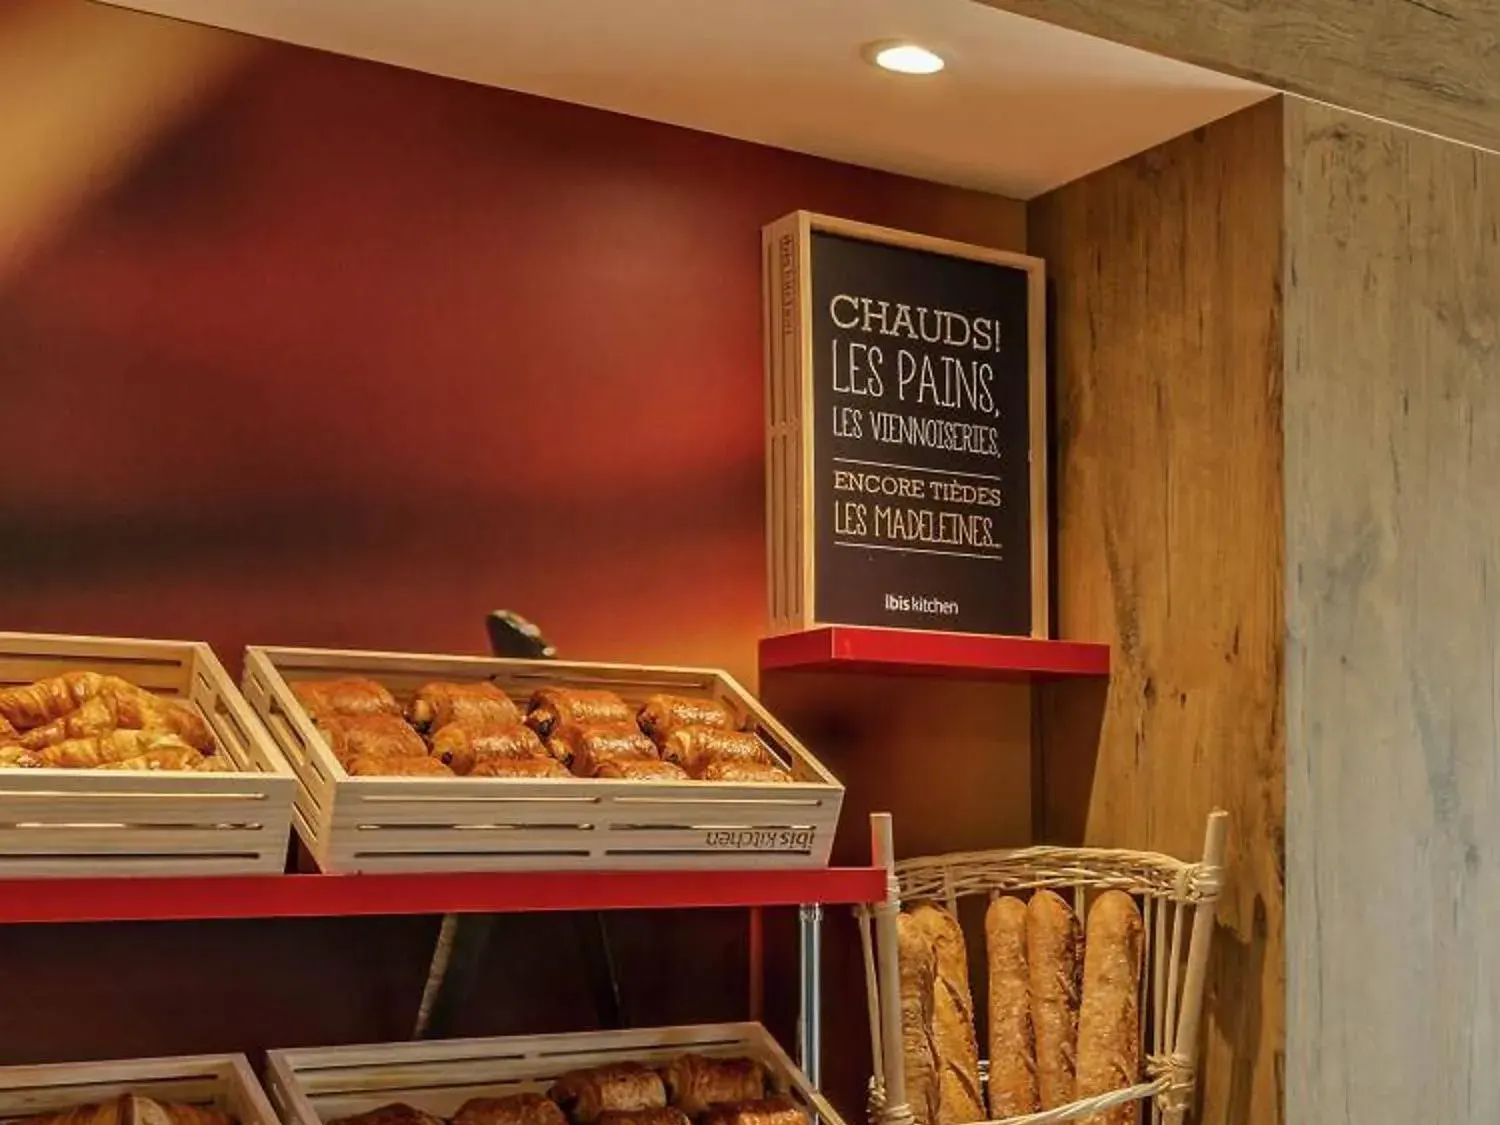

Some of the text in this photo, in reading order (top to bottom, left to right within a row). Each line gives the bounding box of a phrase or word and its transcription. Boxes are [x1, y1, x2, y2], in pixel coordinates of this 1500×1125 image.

[830, 294, 1001, 353] CHAUDS!
[832, 339, 1001, 419] LES PAINS,
[832, 405, 1002, 459] LES VIENNOISERIES,
[833, 469, 1002, 507] ENCORE TIÈDES
[834, 500, 868, 536] LES
[884, 593, 960, 616] ibis kitchen
[705, 831, 815, 849] ibis kitchen
